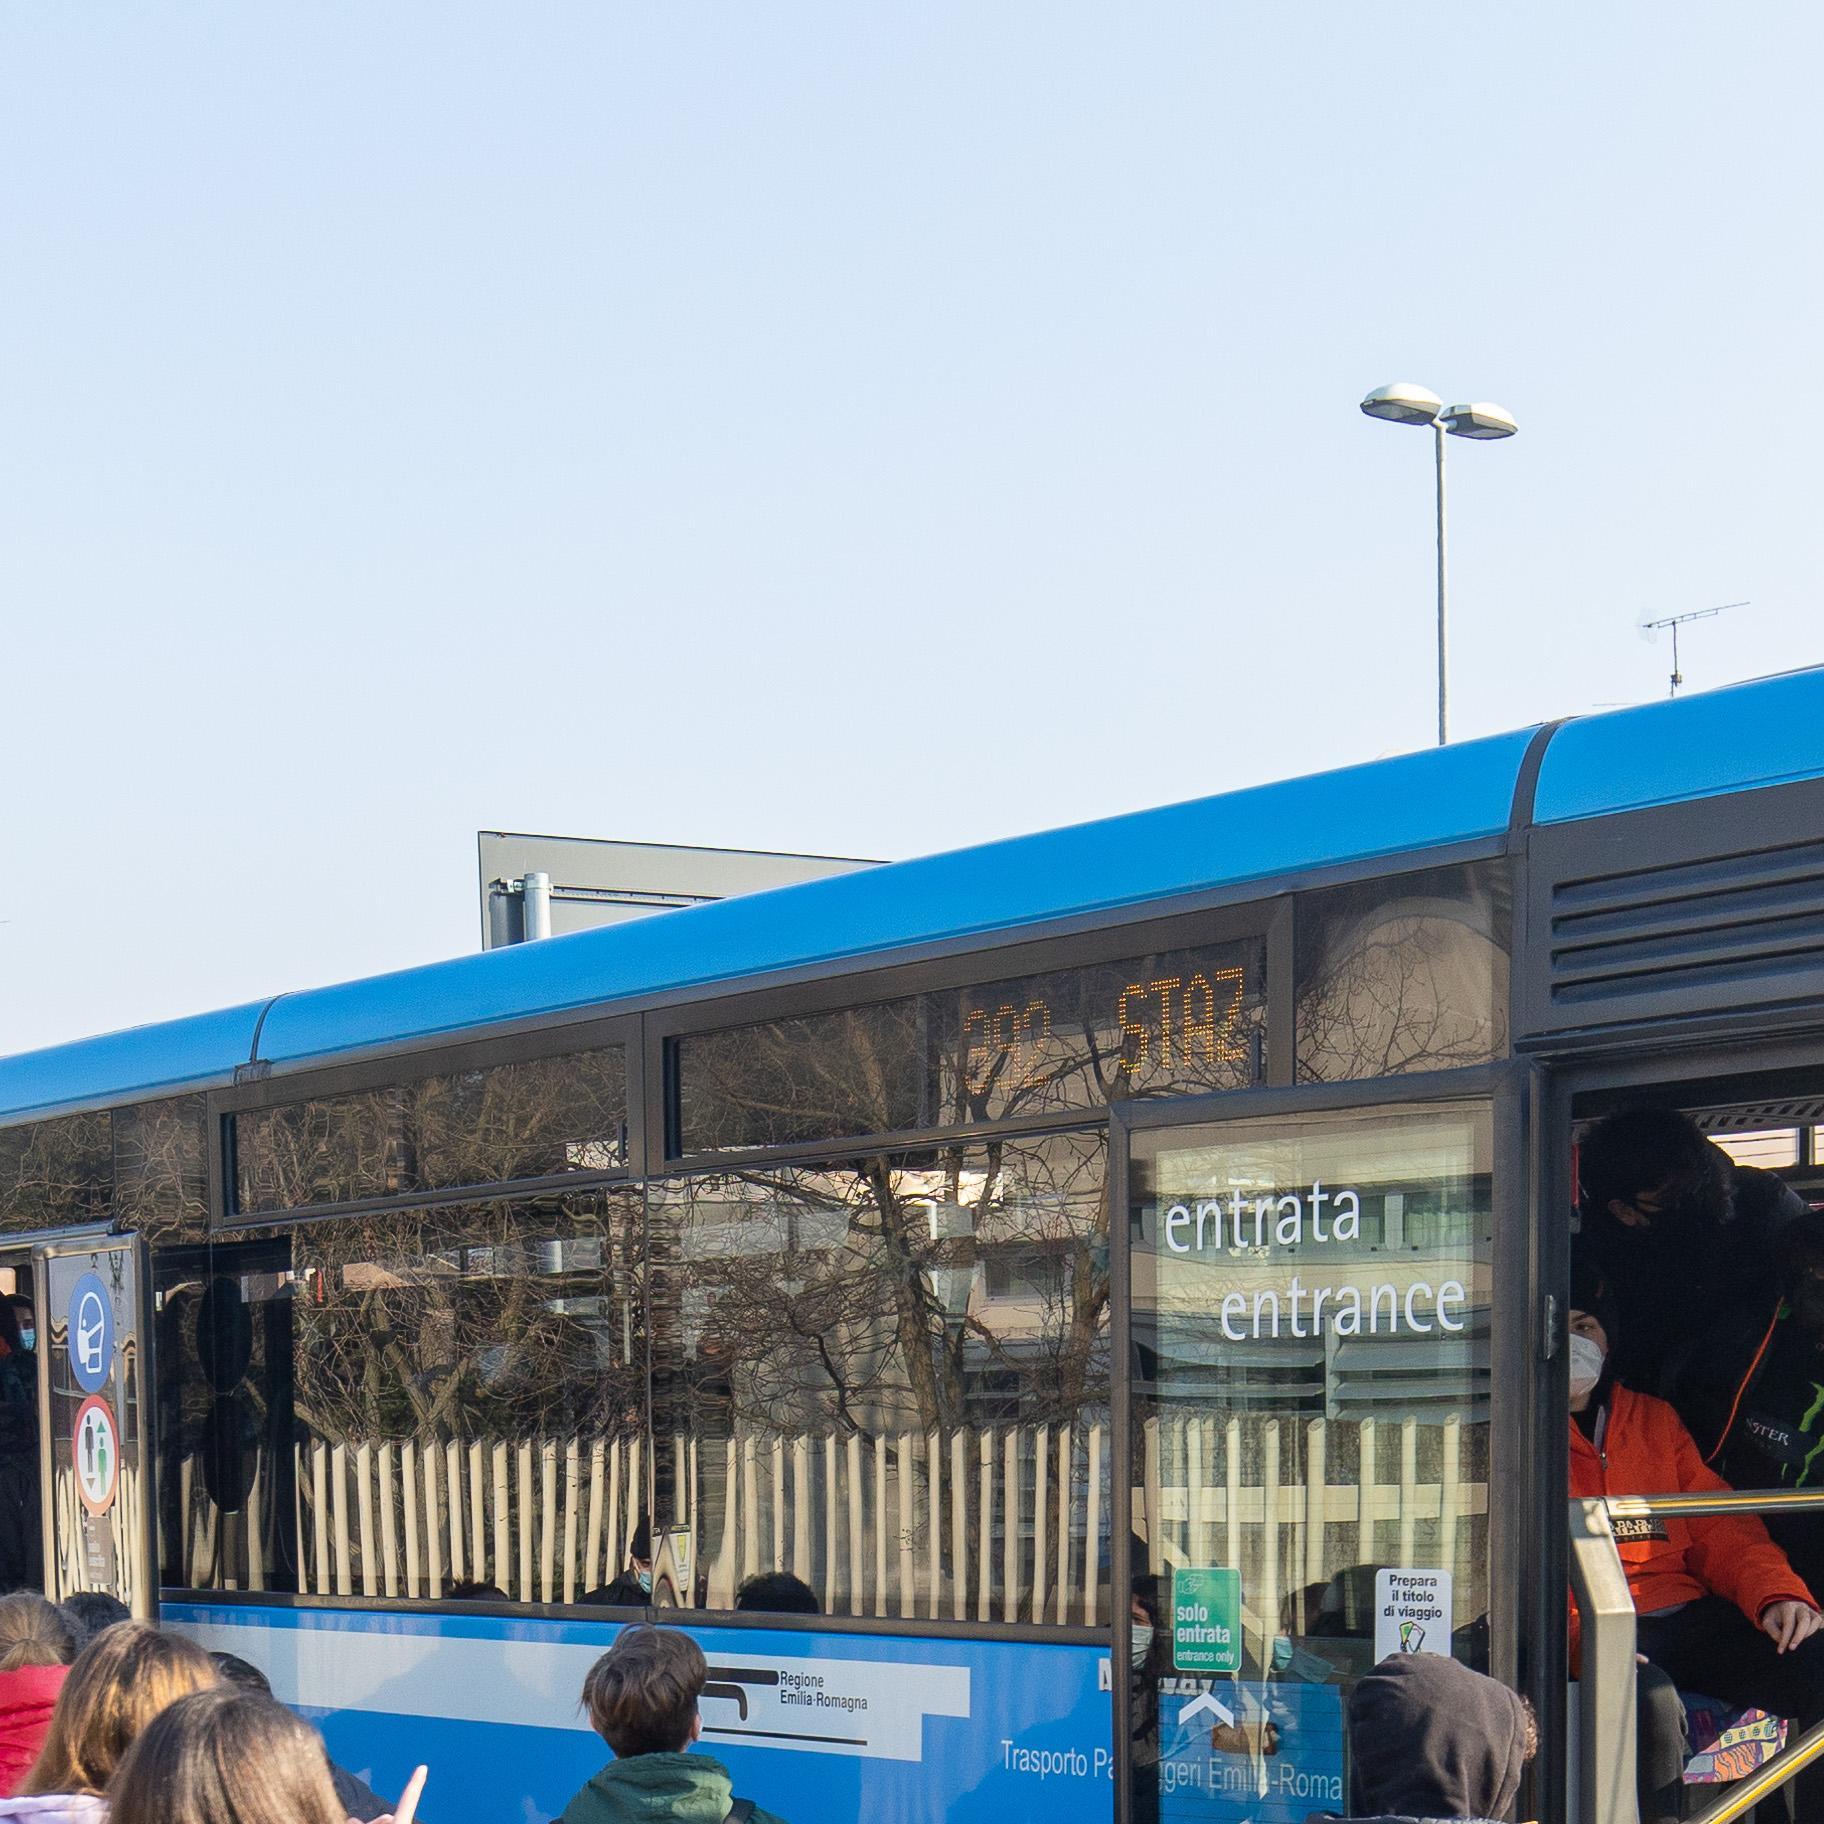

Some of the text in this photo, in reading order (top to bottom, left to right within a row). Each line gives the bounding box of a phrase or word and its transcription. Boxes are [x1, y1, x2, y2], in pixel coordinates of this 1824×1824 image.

[1119, 967, 1245, 1074] STAZ
[1165, 1180, 1360, 1253] entrata
[1220, 1276, 1466, 1341] entrance
[1389, 1574, 1438, 1589] Prepara
[1392, 1590, 1434, 1602] il titolo
[1177, 1602, 1208, 1622] solo
[1384, 1605, 1442, 1621] di viaggio
[1177, 1624, 1230, 1643] entrata
[1177, 1650, 1235, 1665] entrance only
[780, 1671, 824, 1690] Regione
[780, 1689, 868, 1711] Emilia-Romagna
[1001, 1739, 1087, 1780] Trasporto
